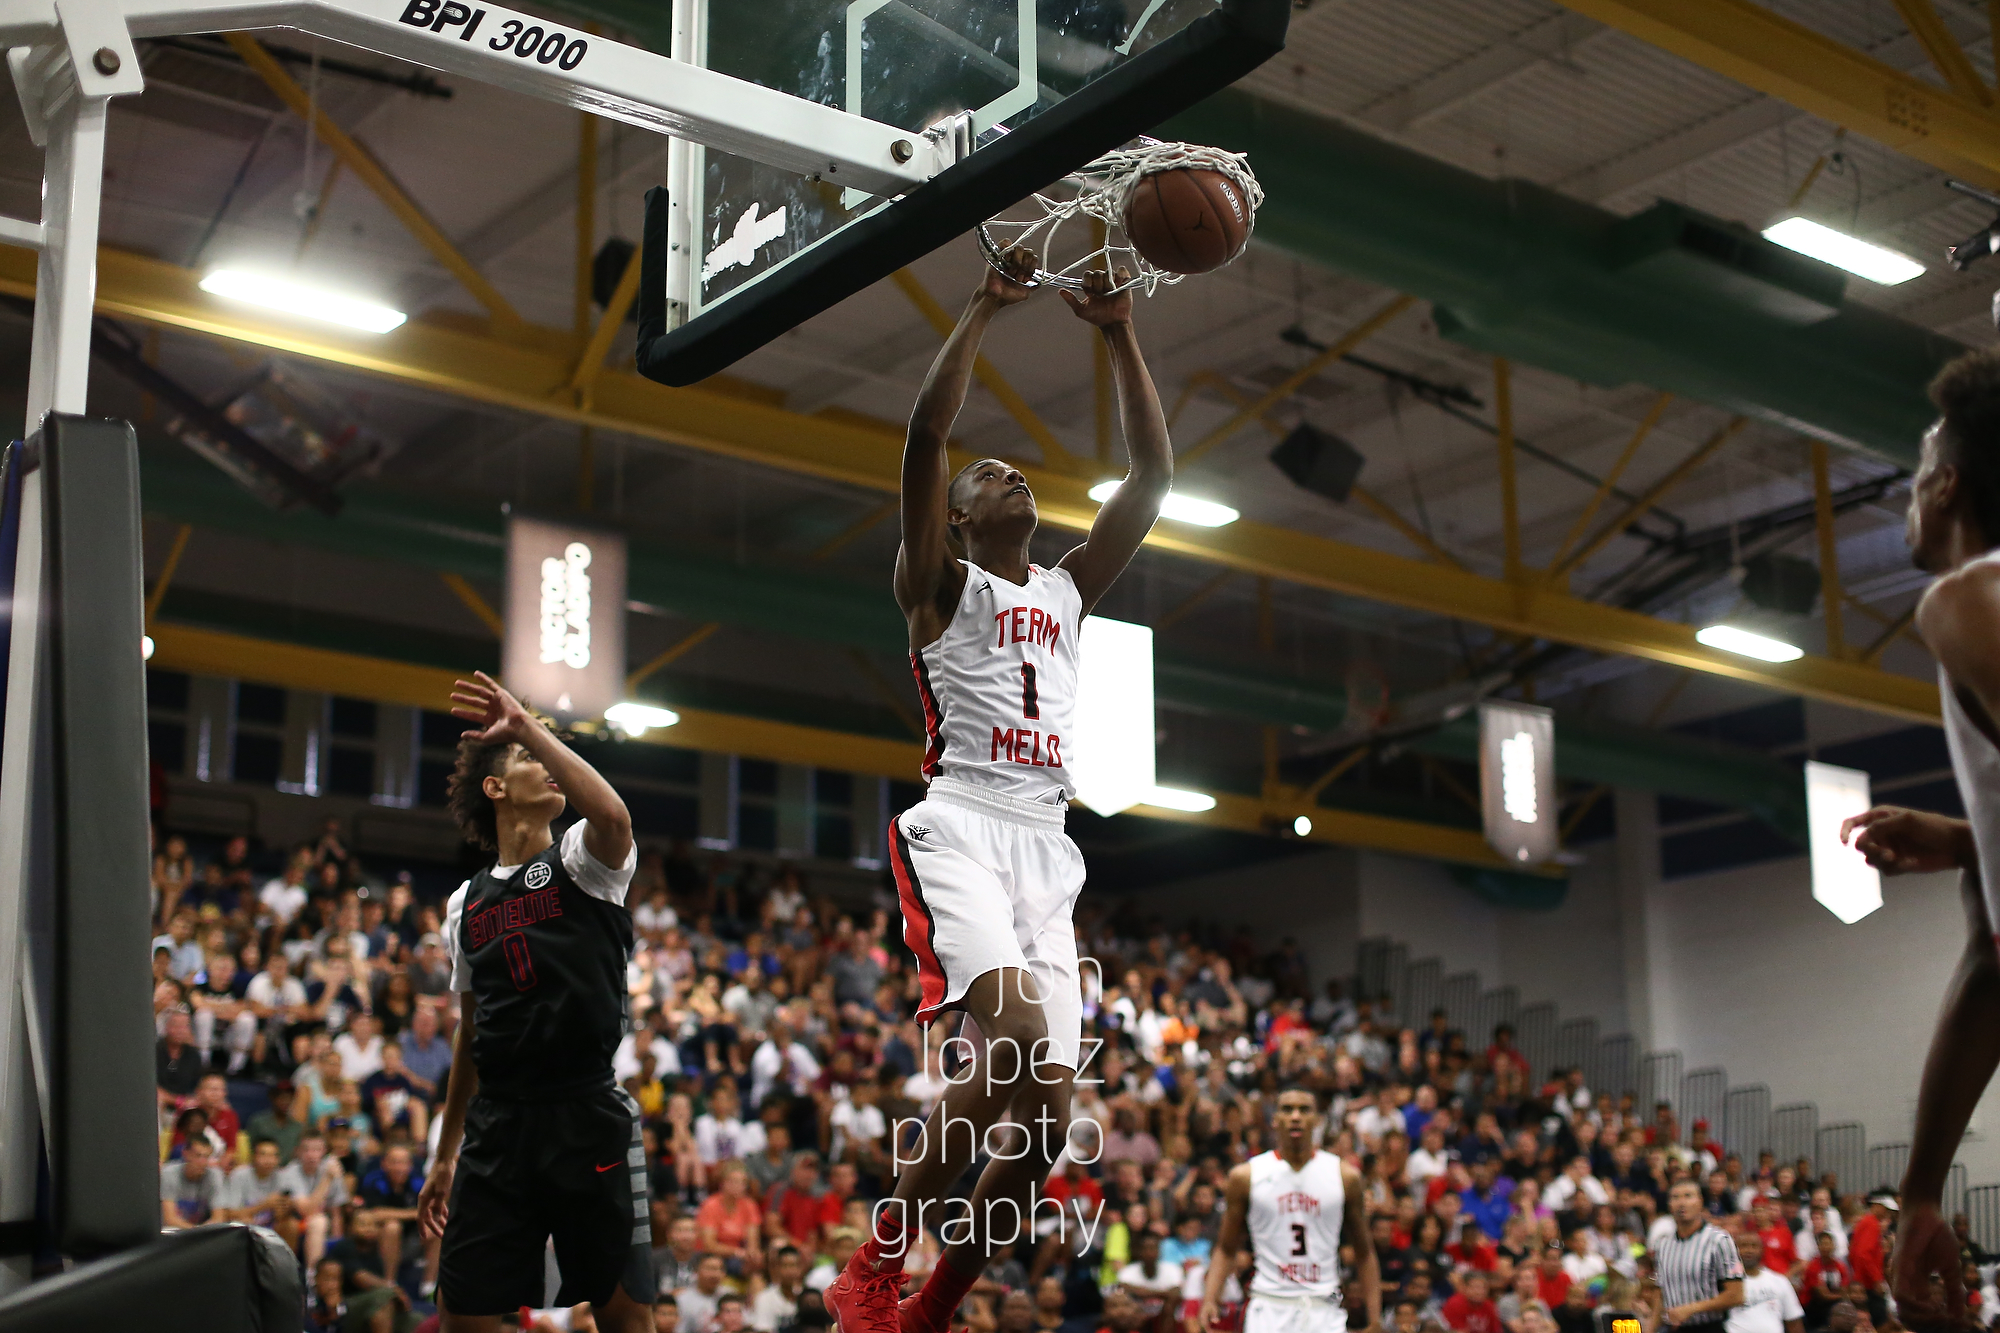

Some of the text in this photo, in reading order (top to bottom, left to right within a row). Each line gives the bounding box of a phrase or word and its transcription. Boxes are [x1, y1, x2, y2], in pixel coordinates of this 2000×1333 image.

[399, 0, 588, 71] BPI 3000
[994, 606, 1061, 657] TEAM
[1020, 661, 1040, 720] 1
[990, 726, 1063, 769] MELO
[503, 931, 538, 992] 0
[1290, 1223, 1308, 1257] 3
